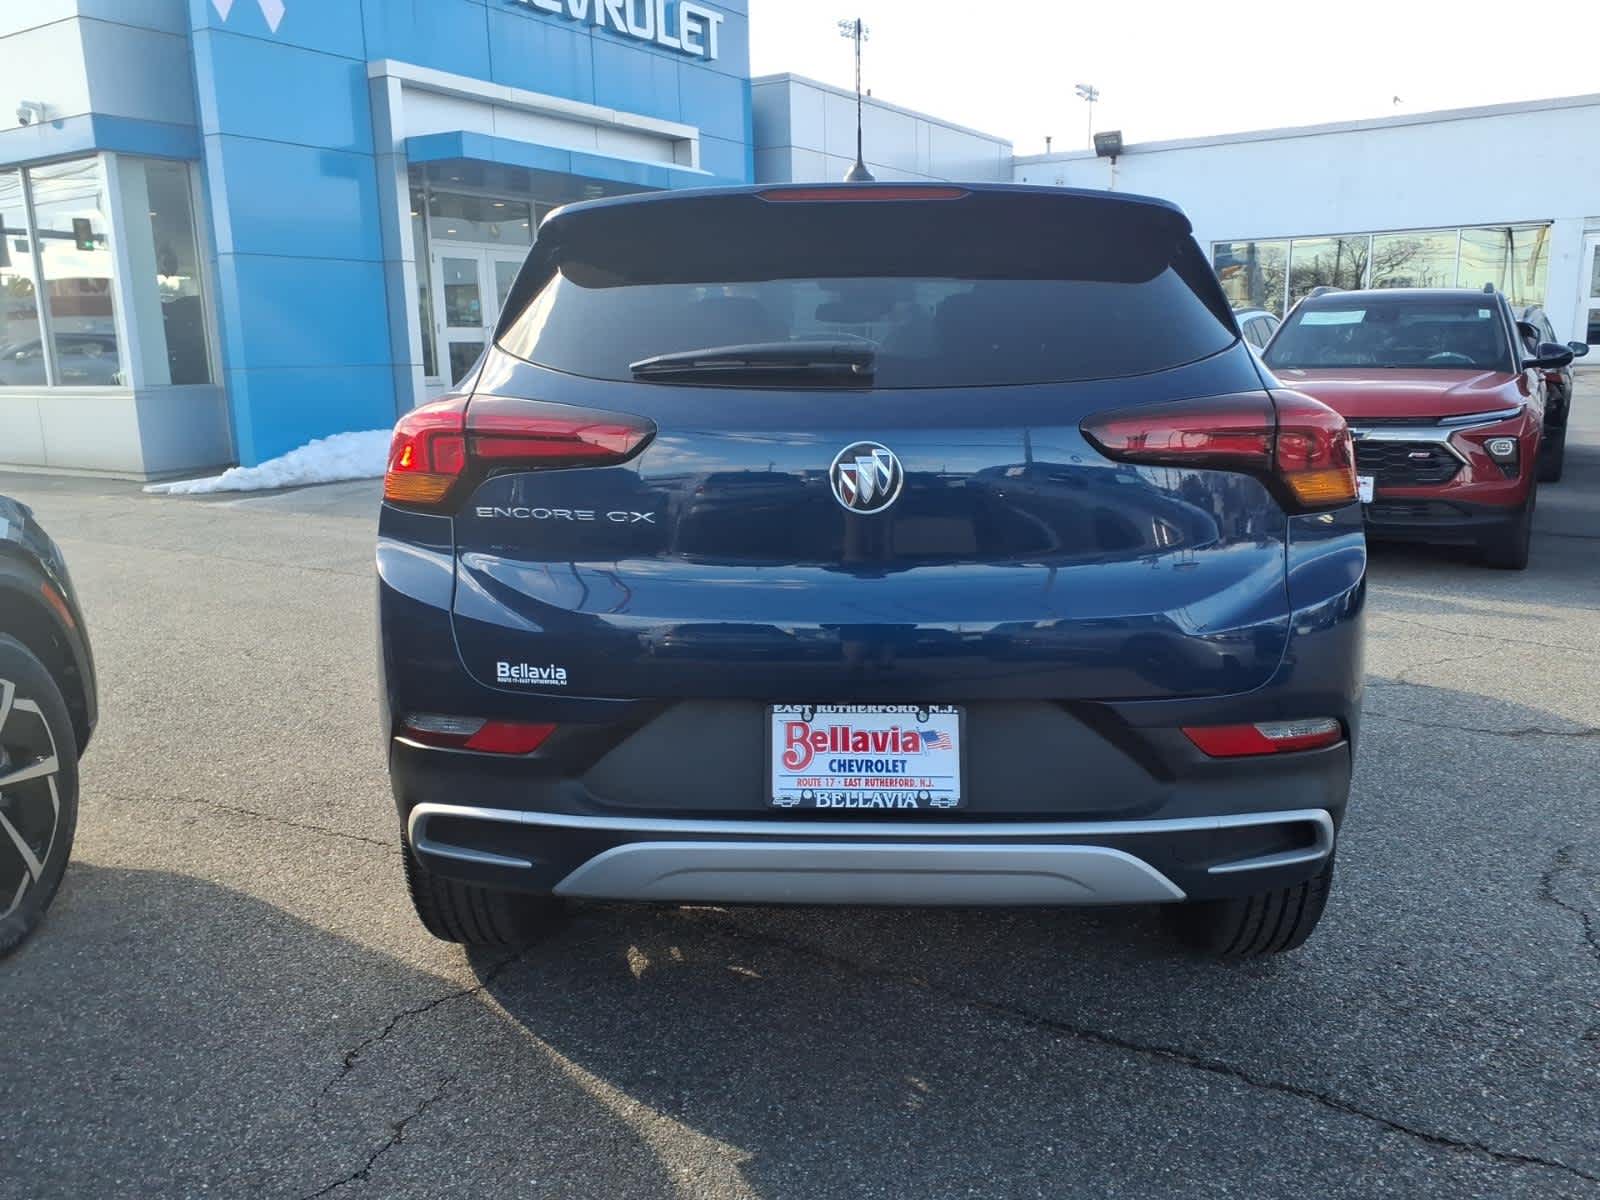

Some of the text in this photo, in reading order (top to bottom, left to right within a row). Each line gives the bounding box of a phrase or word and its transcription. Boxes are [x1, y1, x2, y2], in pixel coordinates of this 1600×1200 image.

[476, 507, 656, 524] ENCORE GX
[496, 661, 567, 680] Bellavia
[773, 705, 811, 714] EAST
[929, 705, 958, 714] N.J.
[782, 720, 921, 772] Bellavia
[828, 758, 908, 774] CHEVROLET
[796, 778, 821, 788] ROUTE
[826, 778, 835, 788] 17
[843, 778, 862, 788] EAST
[815, 791, 919, 809] BELLAVIA
